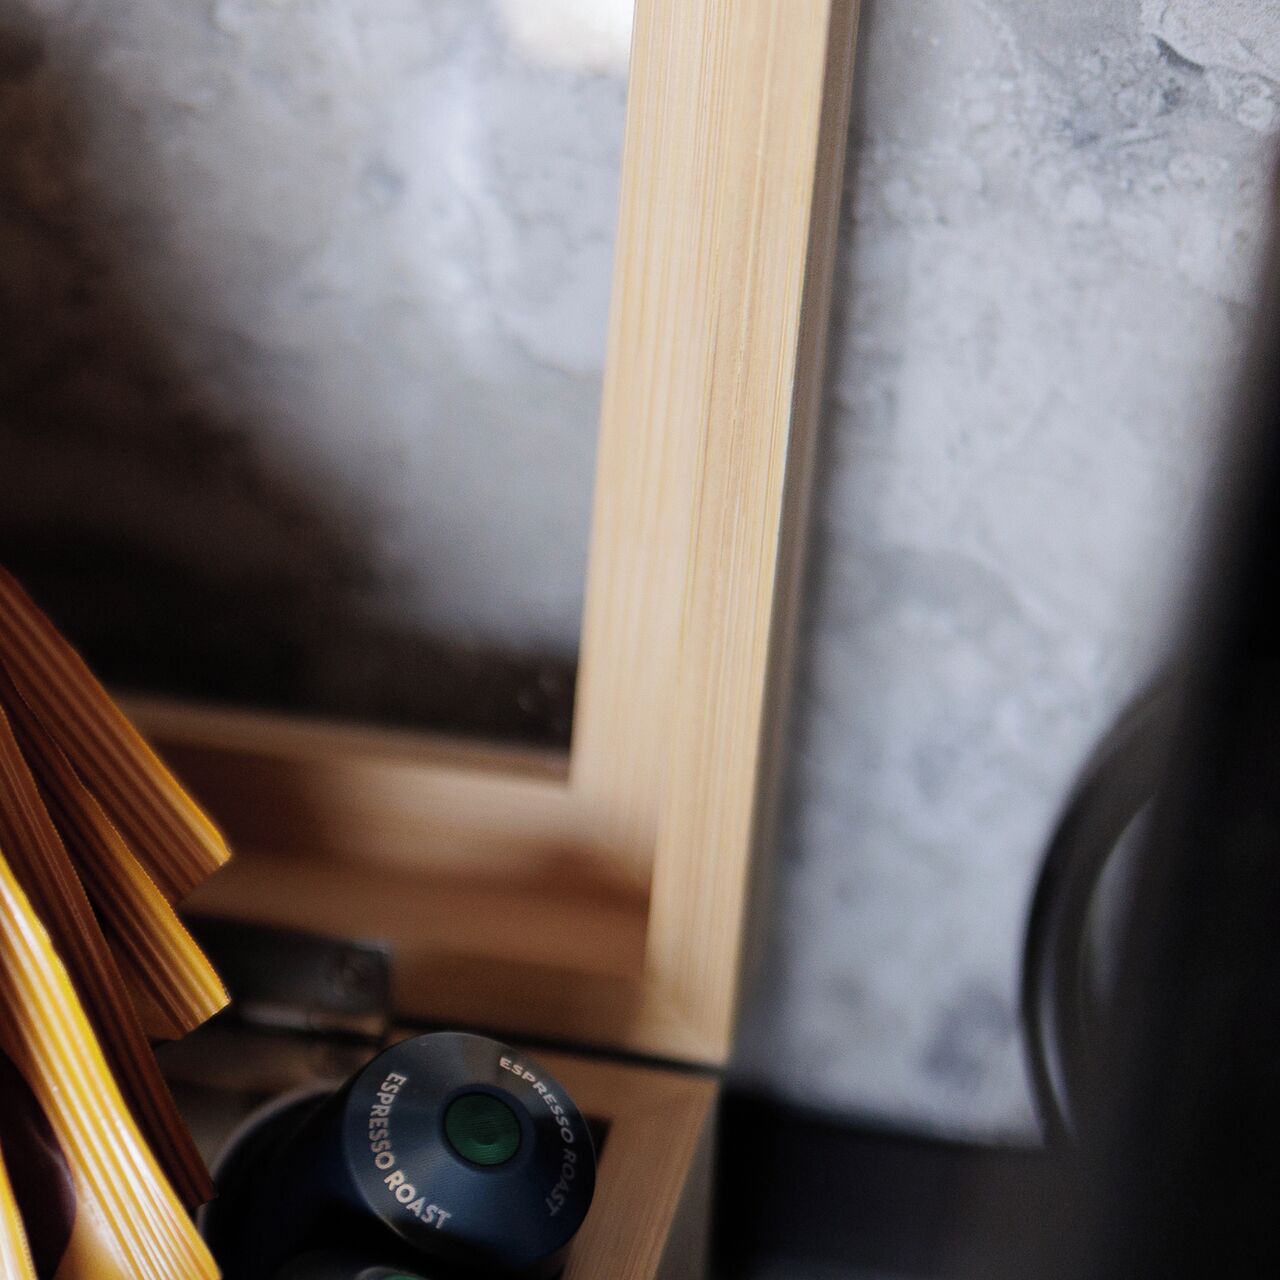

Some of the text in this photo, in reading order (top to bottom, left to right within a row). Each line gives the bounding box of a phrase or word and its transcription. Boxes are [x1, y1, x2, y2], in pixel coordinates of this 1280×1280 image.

[368, 1070, 453, 1229] ESPRESSO ROAST
[499, 1056, 577, 1217] ESPRESSO ROAST
